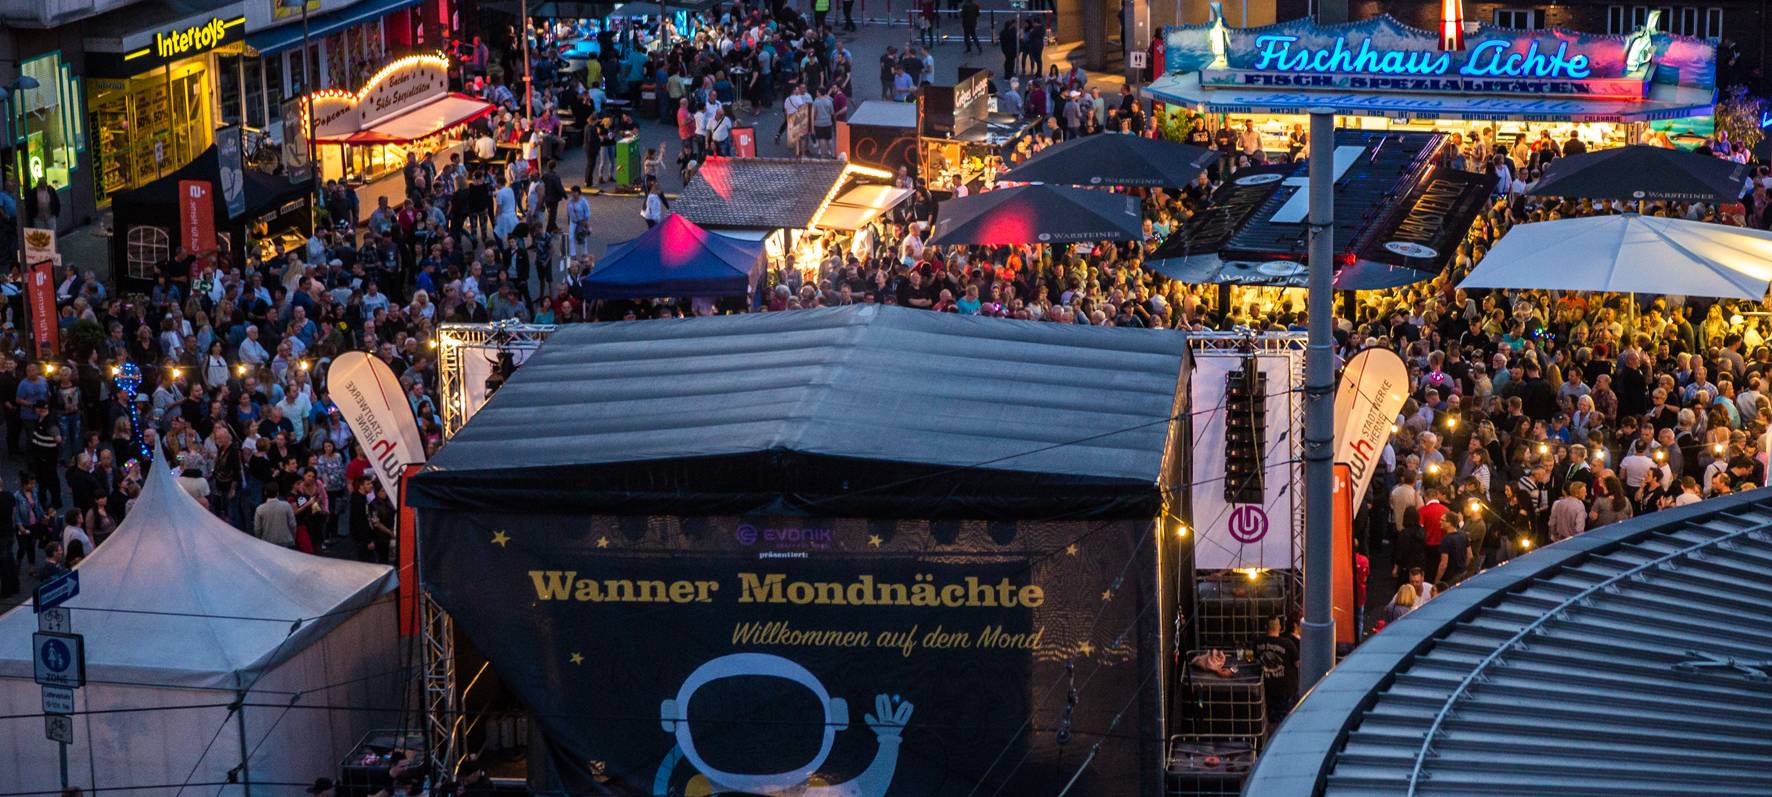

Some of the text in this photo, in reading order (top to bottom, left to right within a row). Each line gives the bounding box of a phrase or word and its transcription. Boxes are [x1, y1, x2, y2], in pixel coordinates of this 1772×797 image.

[157, 17, 225, 57] Intertoys
[1255, 35, 1591, 79] Fischhaus Lichte
[393, 82, 431, 105] Spezialitäten
[1245, 74, 1333, 87] FISCH
[313, 105, 351, 127] Popcorn
[1647, 190, 1715, 200] WARSTEINER
[1051, 231, 1121, 240] WARSTEINER
[1361, 378, 1393, 438] STADTWERKE
[1369, 411, 1387, 445] HERNE
[1349, 439, 1374, 488] wh
[759, 551, 809, 560] präsentiert:
[528, 570, 1045, 608] Wanner Mondnächte
[731, 620, 1046, 658] Willkommen auf dem Mond
